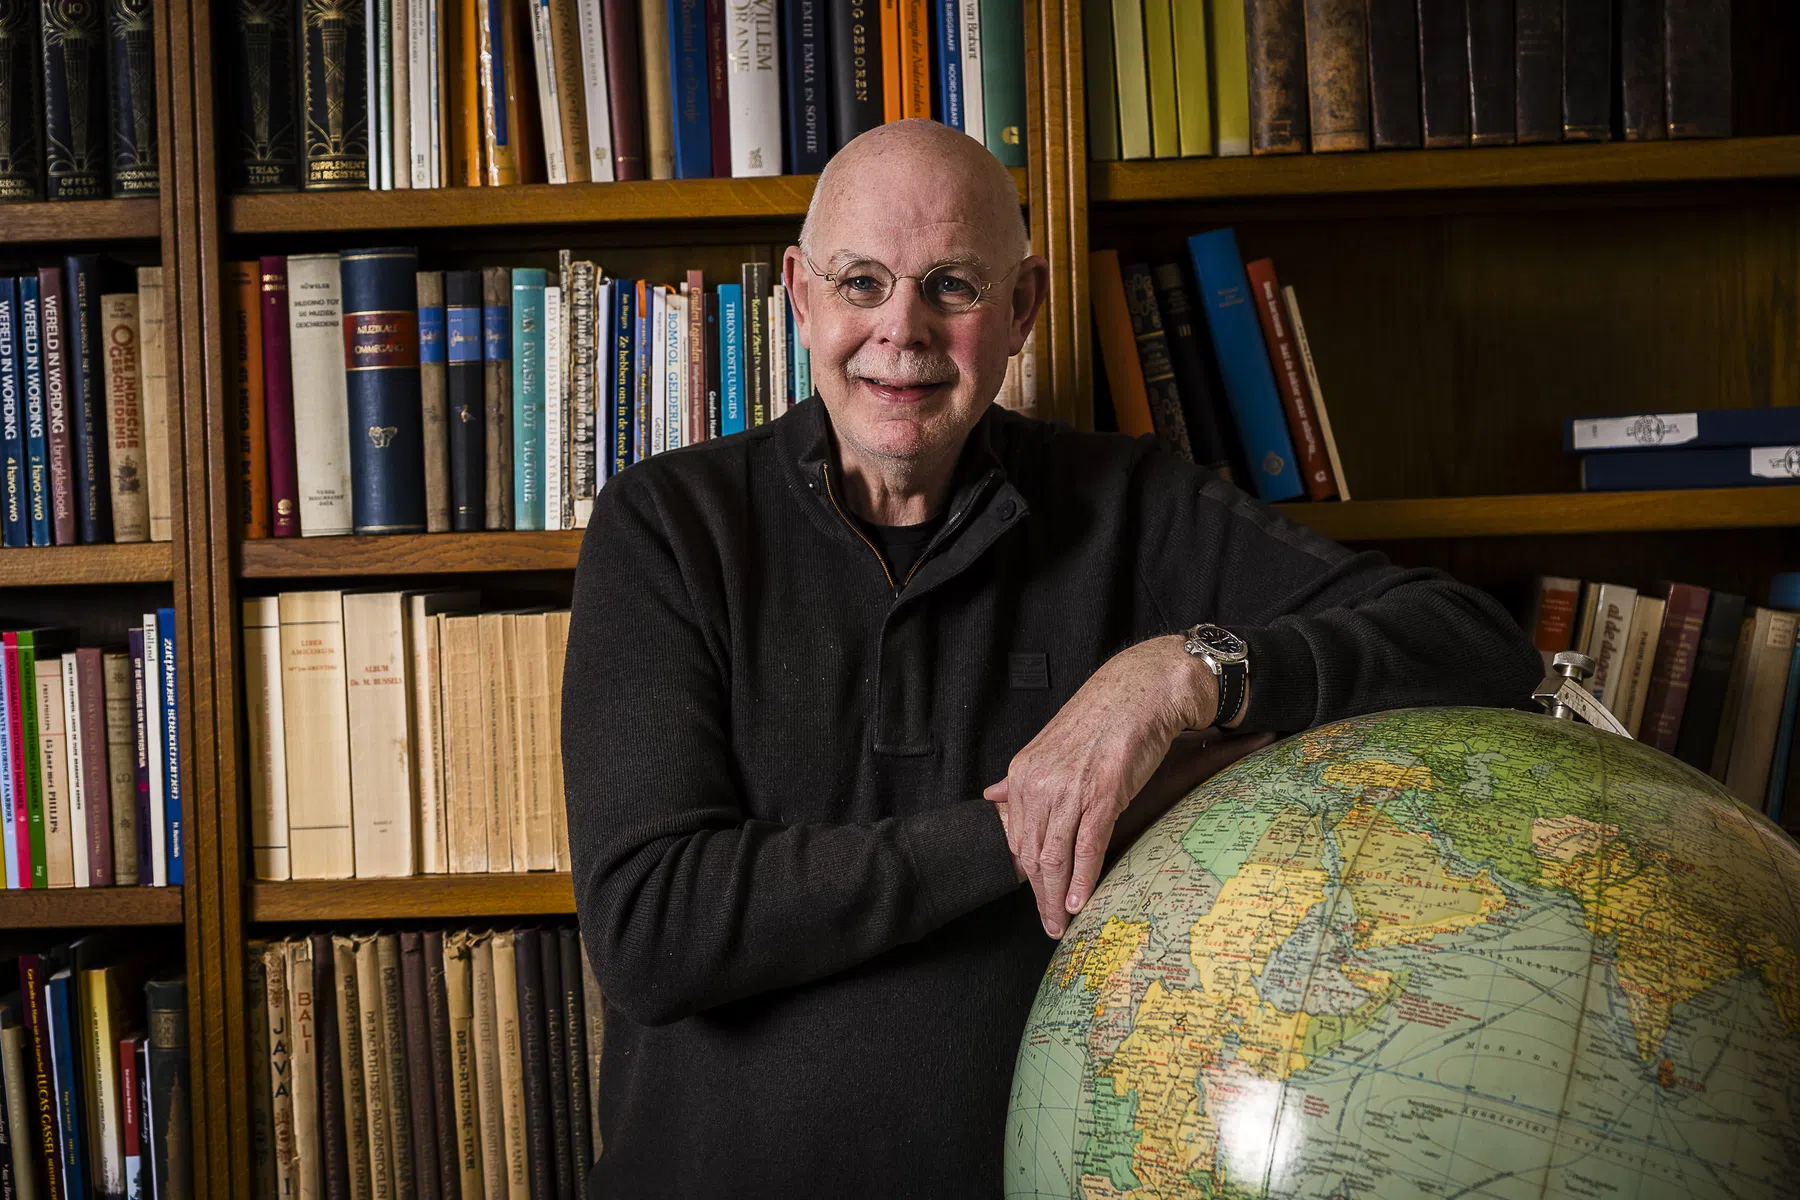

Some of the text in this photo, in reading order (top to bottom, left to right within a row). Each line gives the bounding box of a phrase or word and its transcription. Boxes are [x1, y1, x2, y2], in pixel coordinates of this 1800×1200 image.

[68, 3, 83, 14] 10
[966, 3, 979, 59] van Brabant
[803, 43, 815, 83] EMMA
[853, 24, 868, 102] GEBOREN
[912, 39, 924, 54] der
[944, 3, 959, 126] BURGGRAAFF NOORD-BRABANT
[805, 87, 814, 101] EN
[912, 56, 926, 113] Nederlanden
[805, 105, 817, 153] SOPHIE
[310, 160, 366, 171] SUPPLEMENT
[310, 170, 366, 180] EN REGISTER
[24, 299, 40, 354] WERELD
[43, 295, 59, 350] WERELD
[548, 327, 558, 351] VAN
[668, 313, 678, 366] BOMVOL
[688, 287, 702, 363] Gouden Legenden
[753, 335, 762, 356] Zien!
[2, 358, 14, 371] IN
[27, 356, 40, 370] IN
[48, 352, 60, 366] IN
[354, 343, 404, 354] OMMEGANG
[726, 302, 737, 419] TIRIONS KOSTUUMGIDS
[2, 371, 18, 440] WORDING
[28, 369, 44, 438] WORDING
[48, 365, 65, 434] WORDING
[110, 346, 126, 449] GESCHIEDENIS
[125, 376, 139, 448] INDISCHE
[523, 306, 537, 502] VAN INVASIE TOT VICTORIE
[618, 336, 629, 456] Ze hebben ons in de steek
[708, 391, 717, 418] Gouden
[653, 417, 663, 451] Geldrop
[6, 456, 16, 464] 4
[52, 444, 68, 519] brugklasboek
[6, 466, 20, 522] havo-vwo
[32, 465, 45, 520] havo-vwo
[145, 624, 156, 662] Holland
[1594, 604, 1623, 687] al de dagen
[163, 637, 179, 799] zutphense straatnamen
[11, 721, 22, 770] HISTORISCH
[27, 722, 38, 770] HISTORISCH
[44, 750, 54, 770] jaar
[0, 733, 13, 824] HISTORISCH JAARBOEK
[15, 771, 25, 810] JAARBOEK
[29, 772, 40, 810] JAARBOEK
[47, 771, 55, 789] met
[33, 814, 40, 823] 11
[48, 791, 59, 834] PHILIPS
[297, 992, 312, 1054] BALI
[272, 1017, 289, 1098] JAVA
[36, 1073, 50, 1112] LUCAS
[40, 1113, 55, 1156] GASSEL
[372, 1109, 387, 1199] PADDENSTOELEN
